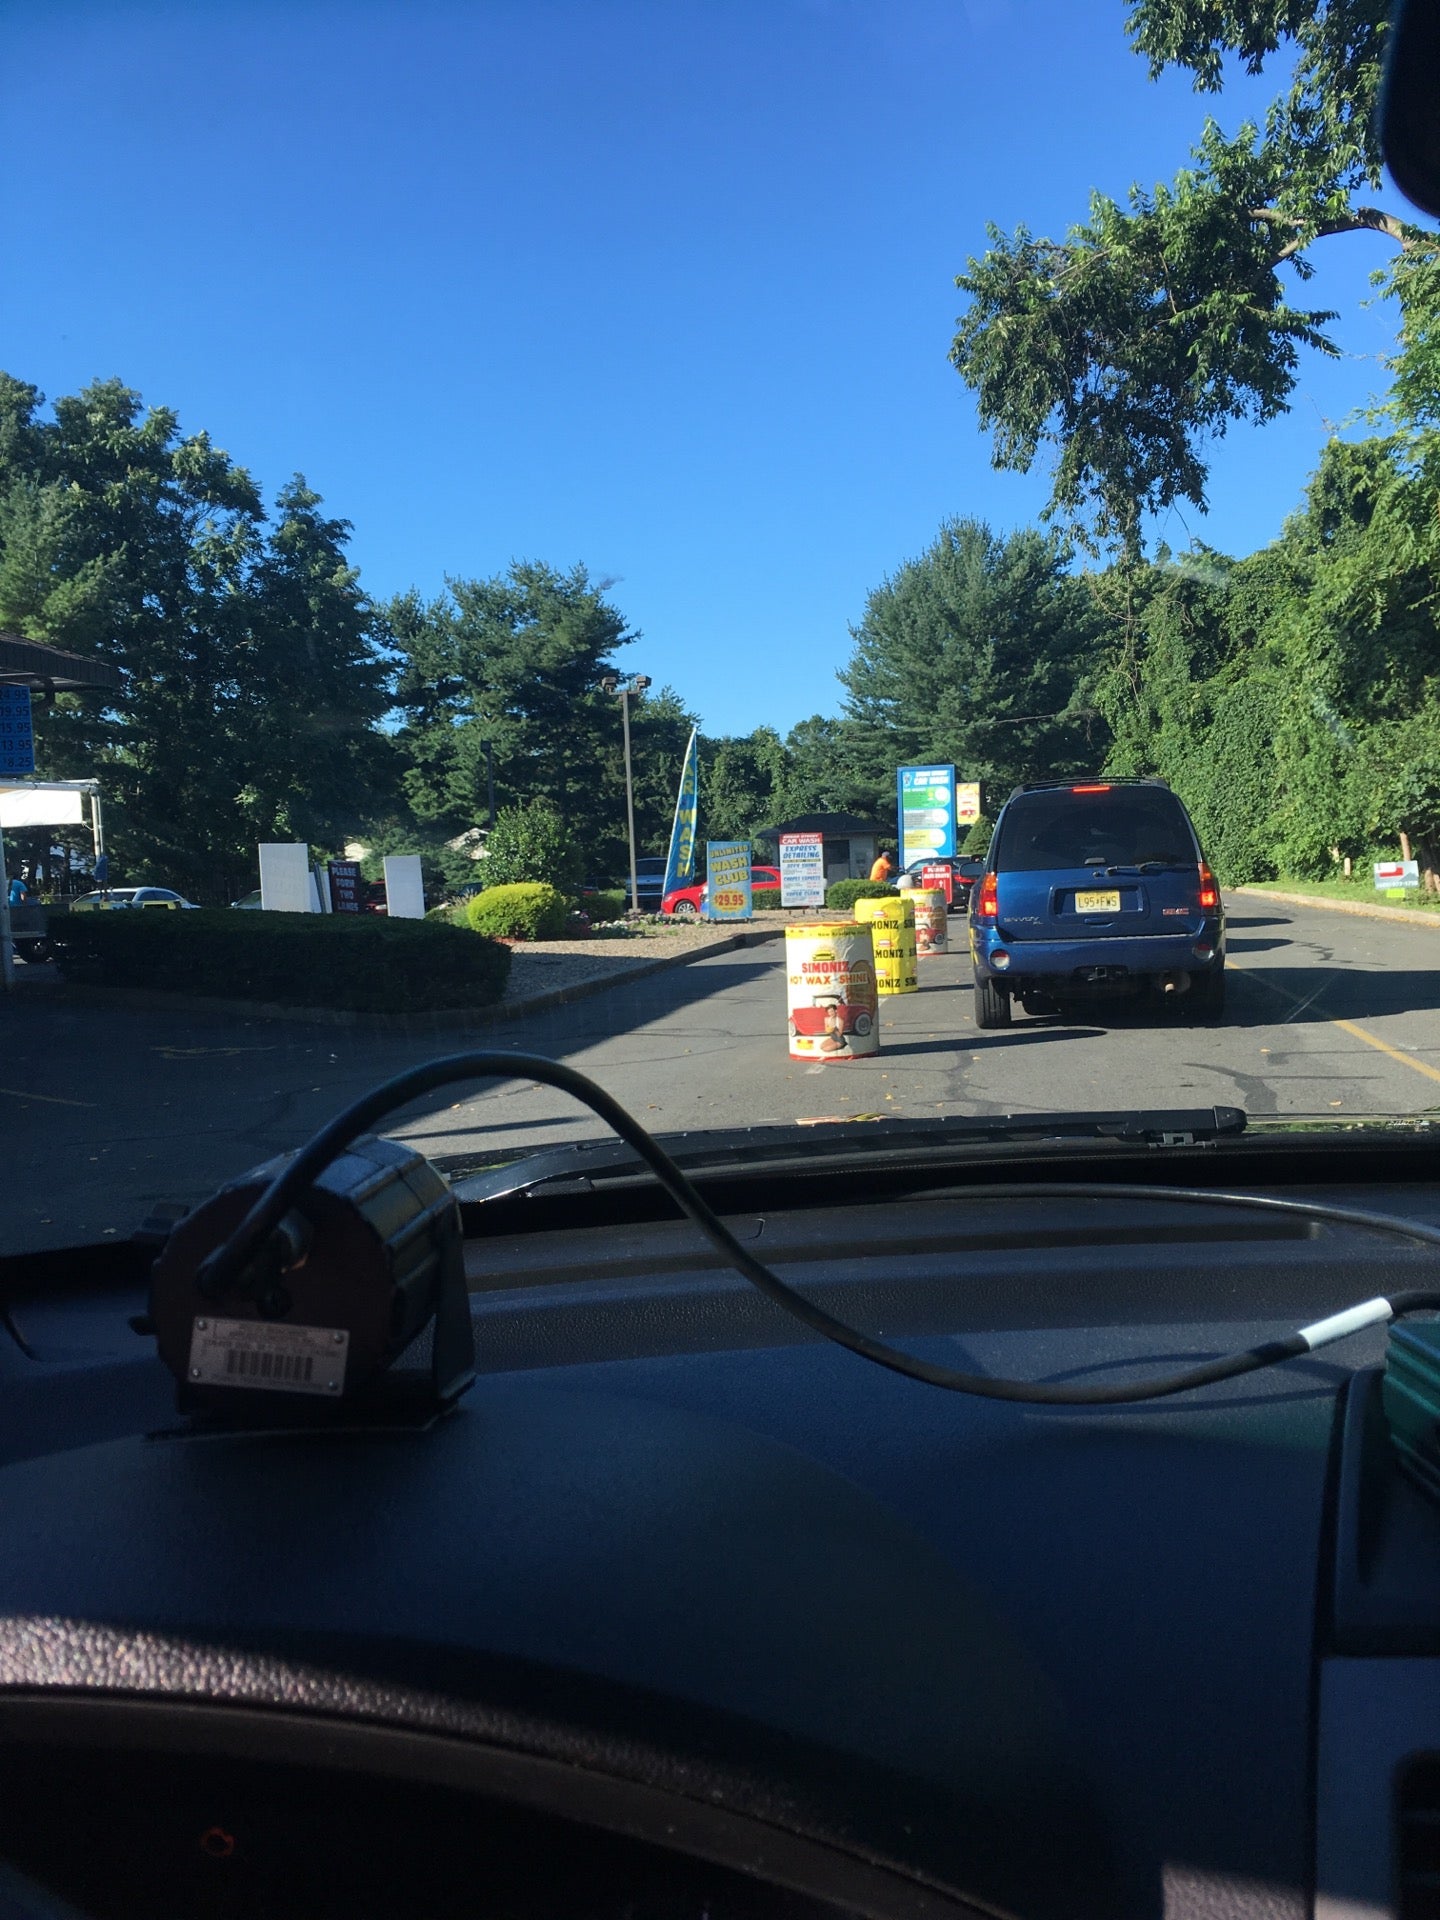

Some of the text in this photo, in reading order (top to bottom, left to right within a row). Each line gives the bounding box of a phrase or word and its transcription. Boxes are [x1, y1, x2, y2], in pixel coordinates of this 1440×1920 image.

[677, 809, 697, 877] WASH
[783, 851, 820, 859] DETAILING
[710, 856, 748, 872] WASH
[332, 867, 357, 877] PLEASE
[715, 870, 749, 886] CLUB
[714, 894, 744, 906] $29.95
[871, 920, 899, 929] MONIZ
[875, 949, 904, 958] MONIZ
[802, 961, 849, 973] SIMONIZ
[805, 976, 831, 985] WAX
[839, 973, 866, 984] SHINE
